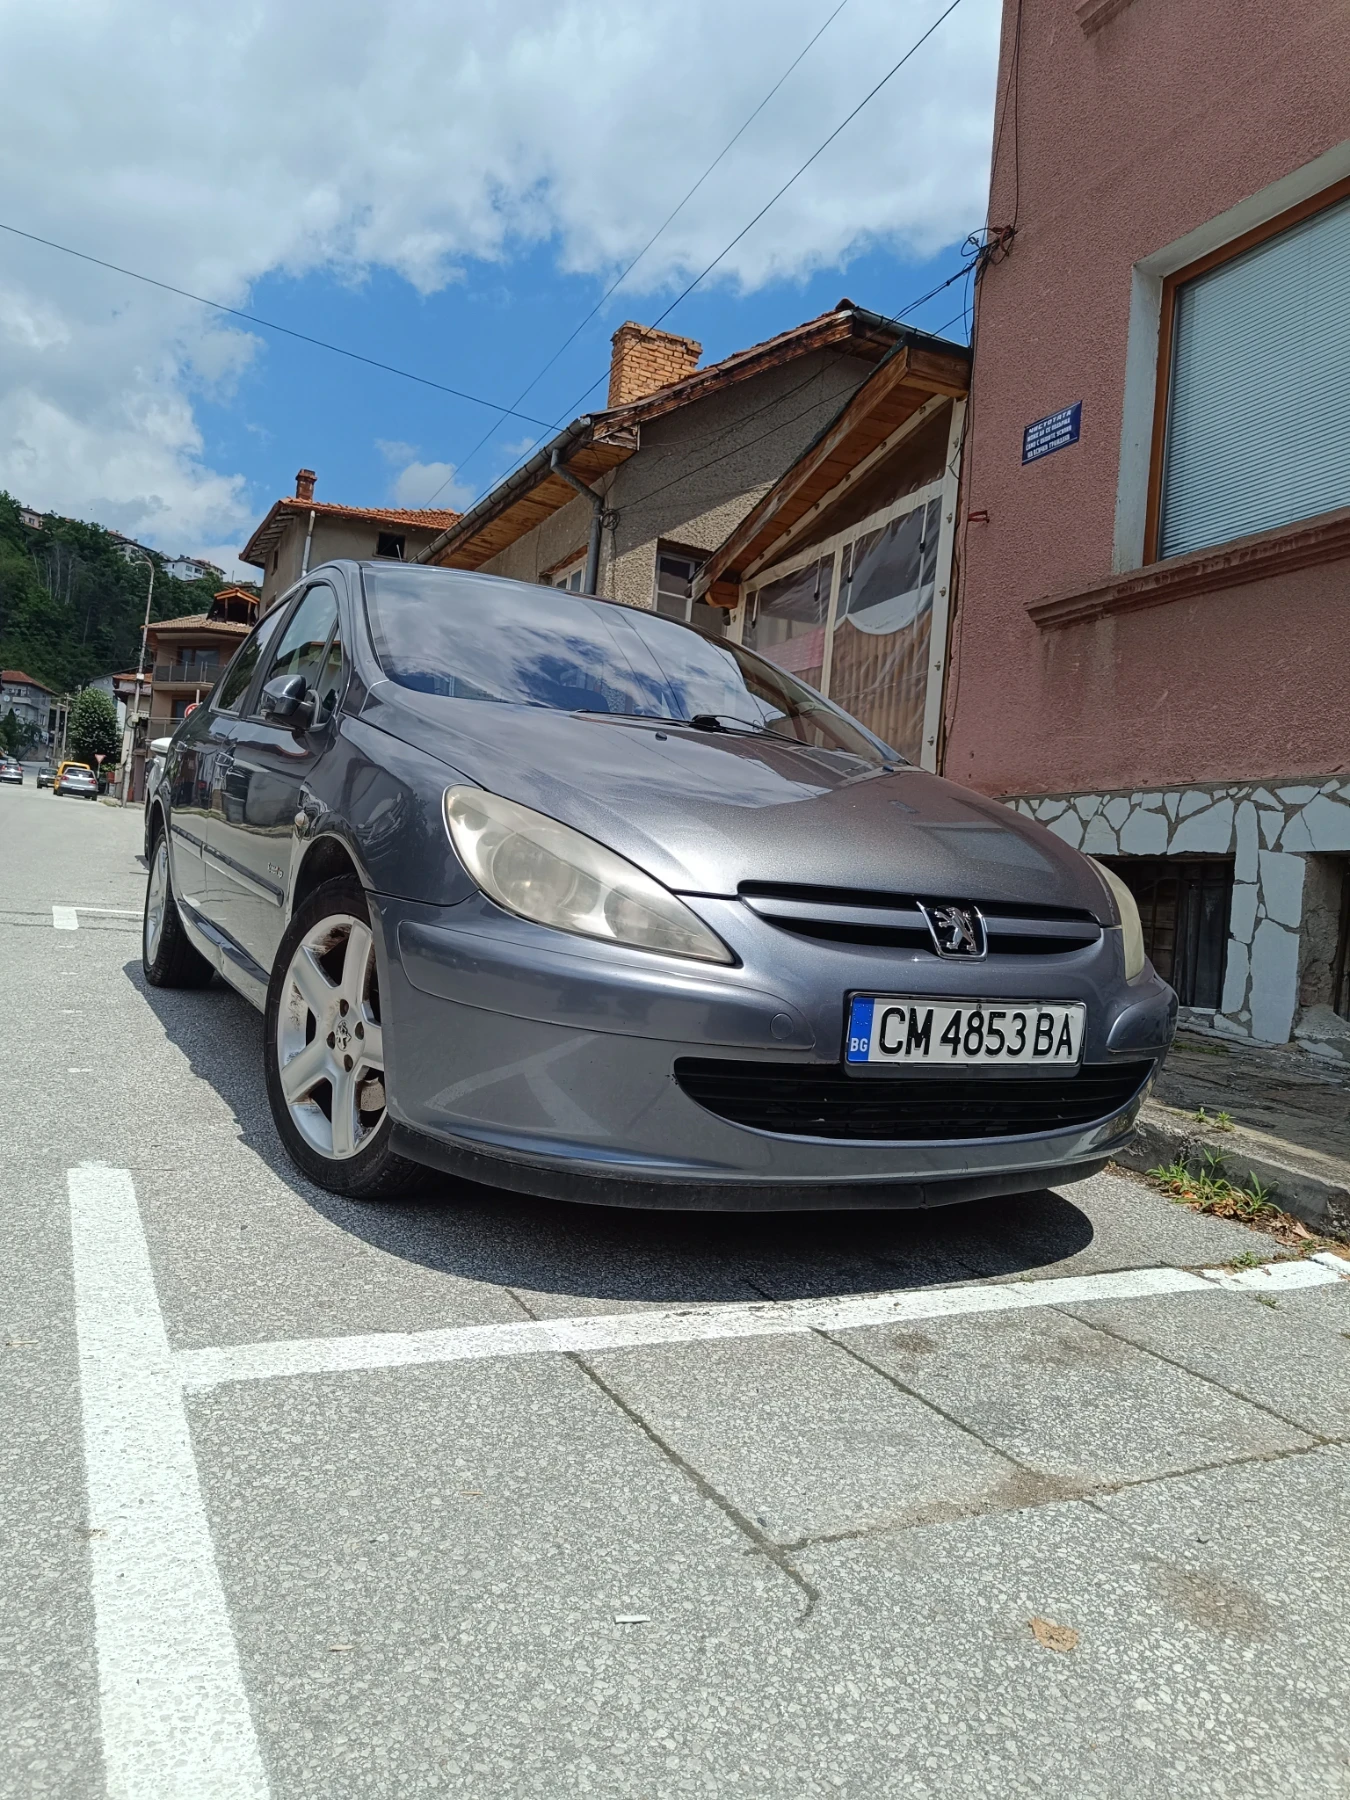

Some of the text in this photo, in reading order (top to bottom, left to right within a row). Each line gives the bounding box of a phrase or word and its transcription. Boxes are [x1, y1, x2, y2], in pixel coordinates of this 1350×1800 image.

[1028, 410, 1072, 433] ЧИСТОТАТА
[850, 1007, 1073, 1058] BG CM 4853 BA
